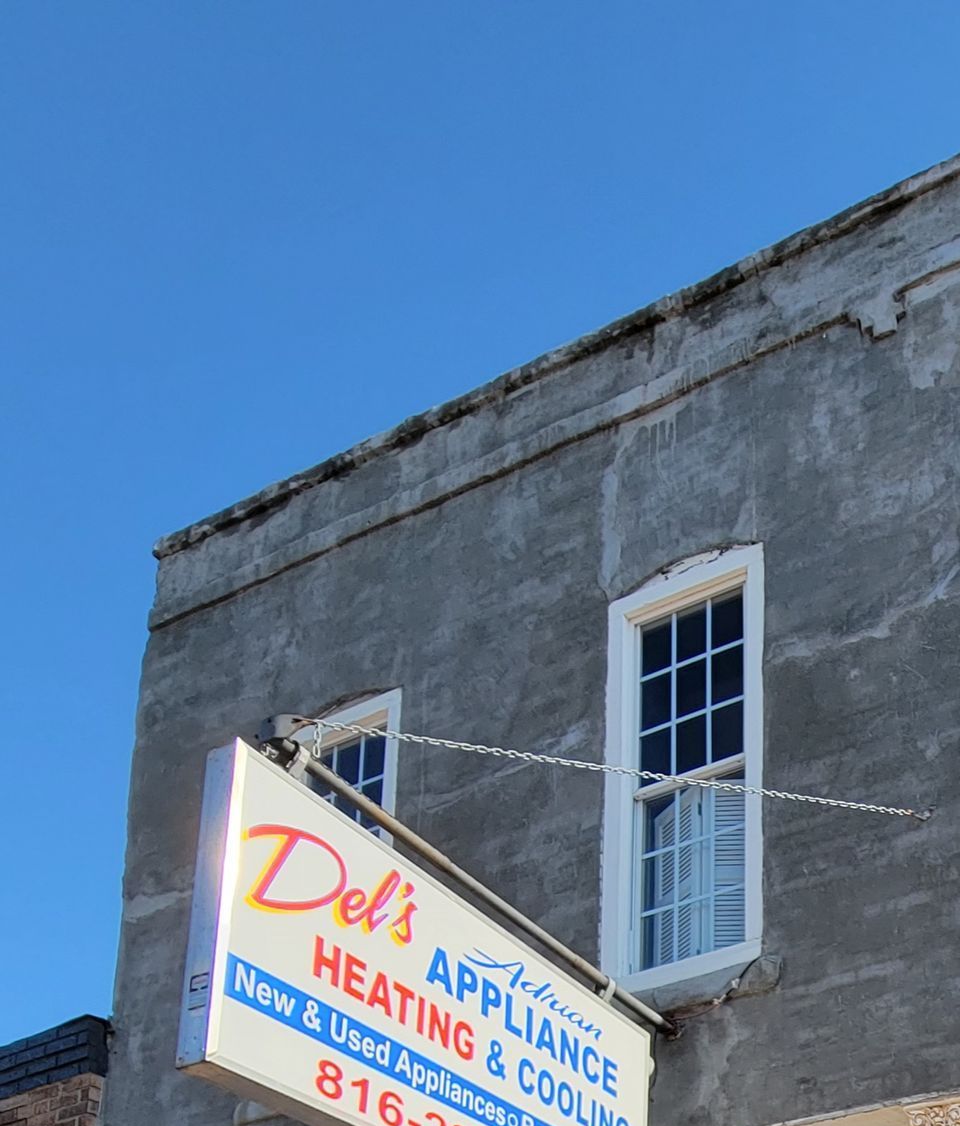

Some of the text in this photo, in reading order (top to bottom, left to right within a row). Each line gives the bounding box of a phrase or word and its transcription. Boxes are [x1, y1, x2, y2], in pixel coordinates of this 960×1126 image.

[241, 823, 418, 948] Del's
[234, 962, 296, 1017] New
[302, 999, 322, 1032] &
[330, 1011, 390, 1067] Used
[394, 1049, 506, 1126] Appliances
[313, 934, 475, 1060] HEATING
[486, 1039, 506, 1081] &
[425, 947, 618, 1098] APPLIANCE
[463, 947, 602, 1040] Adrian
